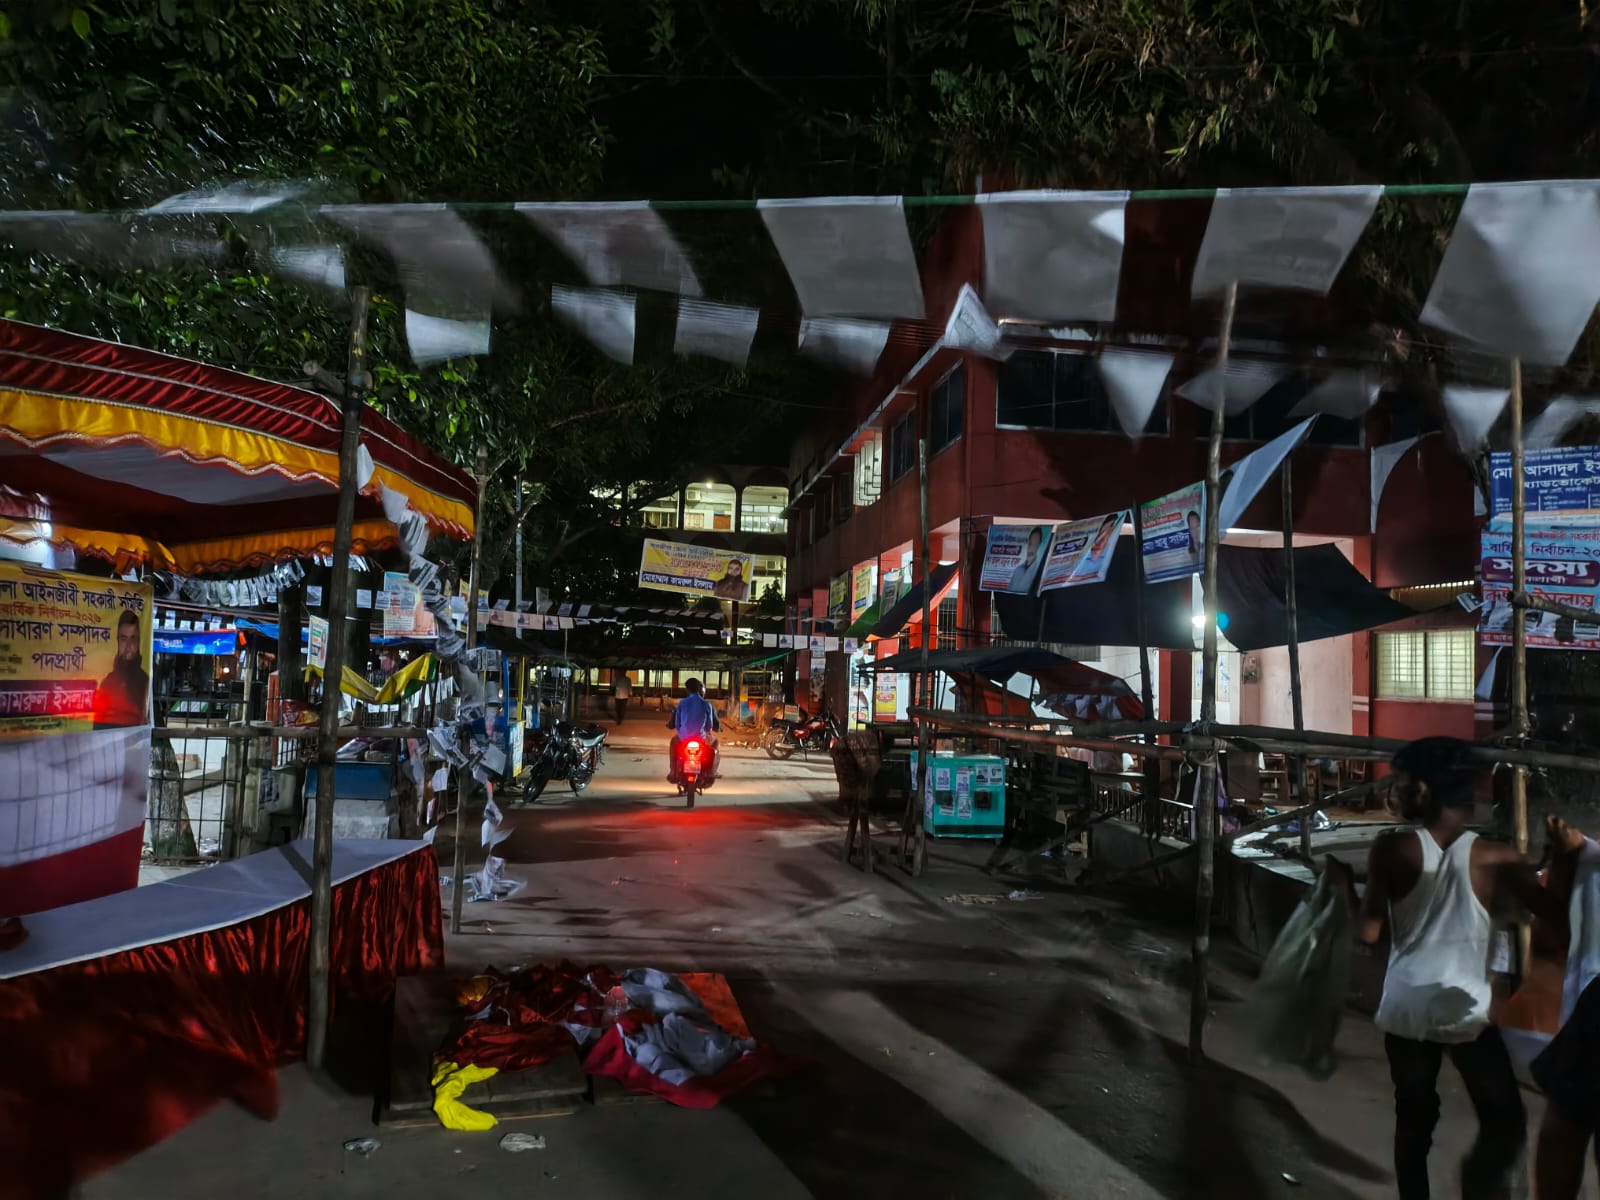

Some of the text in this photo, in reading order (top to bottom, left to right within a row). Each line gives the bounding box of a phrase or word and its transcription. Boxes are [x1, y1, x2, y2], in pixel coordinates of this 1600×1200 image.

[22, 580, 80, 606] আইনজীবী
[82, 588, 116, 610] সহকারী
[118, 592, 145, 612] সমিতি
[58, 622, 112, 644] সম্পাদক
[52, 684, 96, 711] ইসলাম
